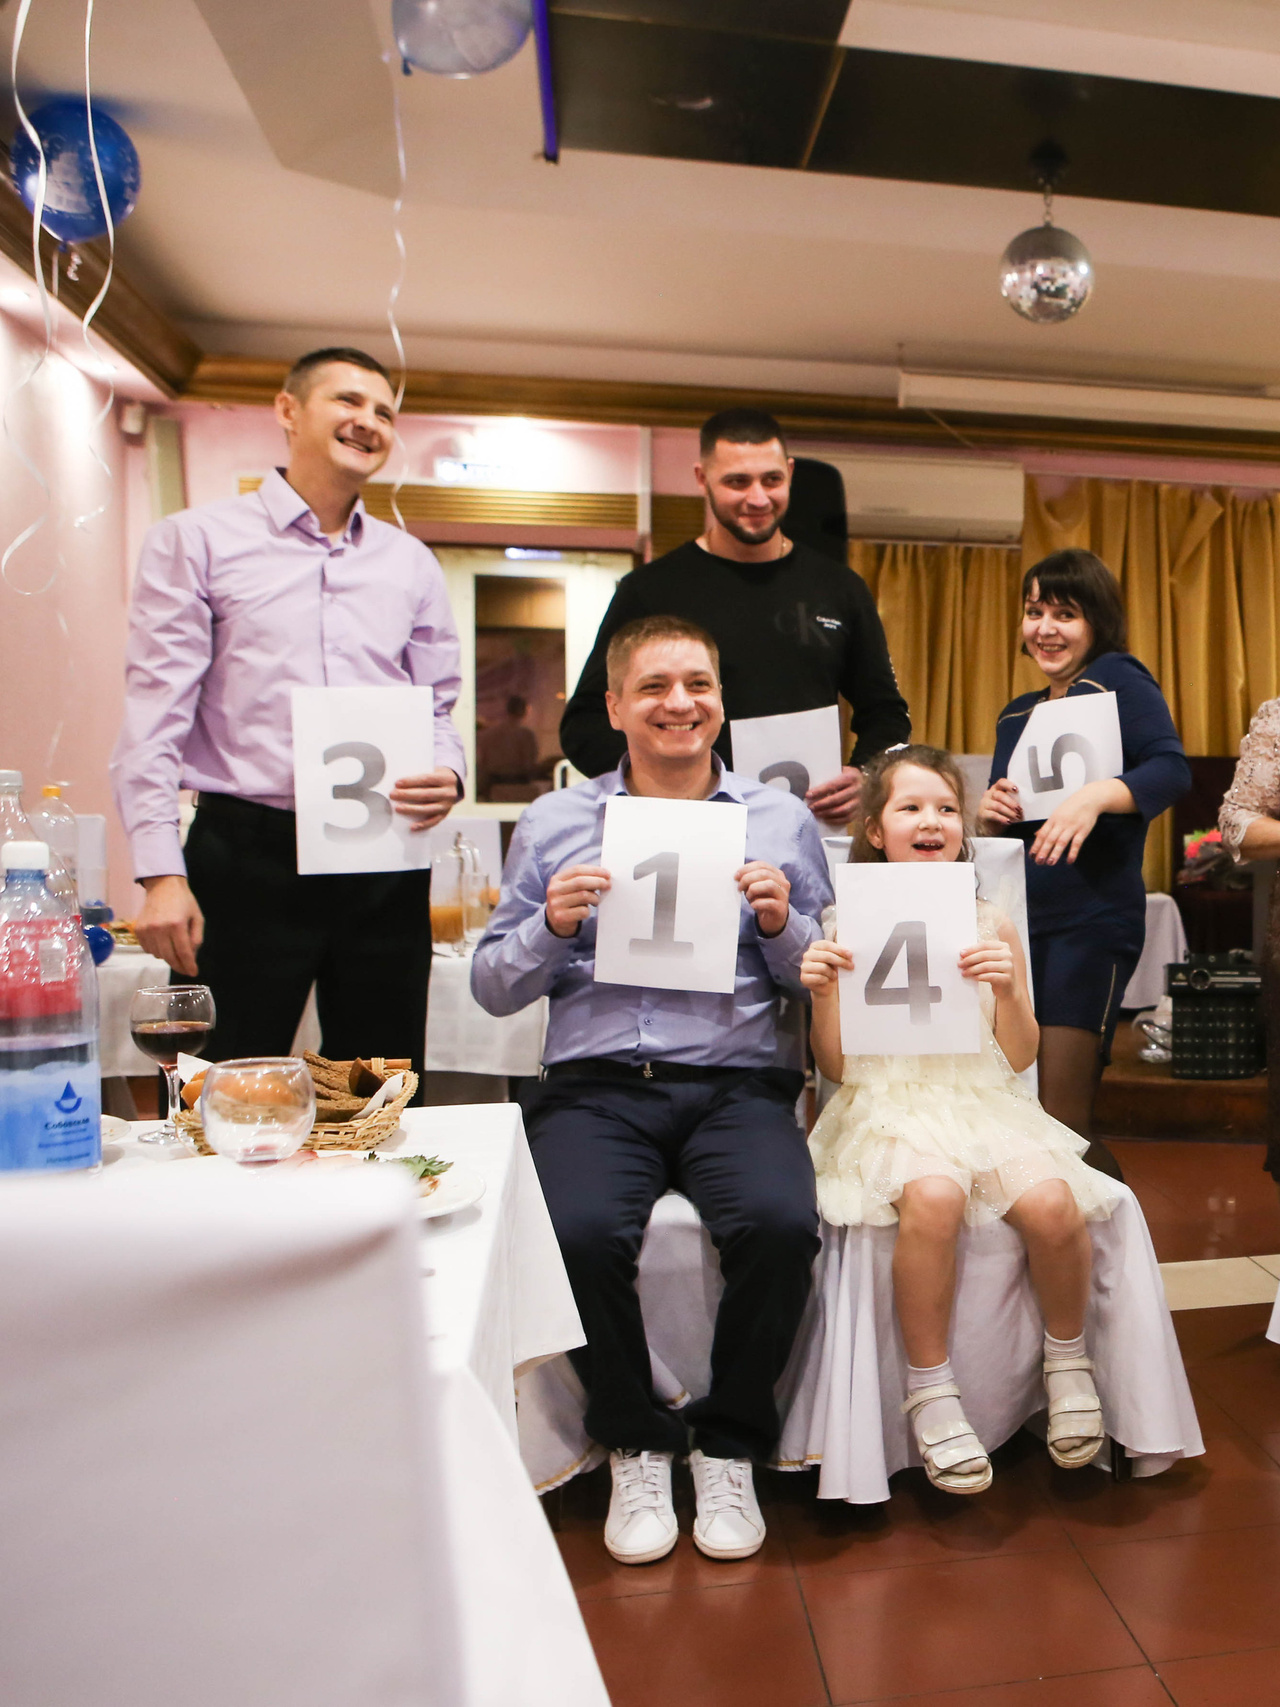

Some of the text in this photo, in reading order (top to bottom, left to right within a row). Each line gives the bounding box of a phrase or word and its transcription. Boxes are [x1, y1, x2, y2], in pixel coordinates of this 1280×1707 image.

[322, 741, 393, 844] 3
[1028, 733, 1100, 794] 5
[629, 851, 694, 955] 1
[864, 921, 942, 1025] 4
